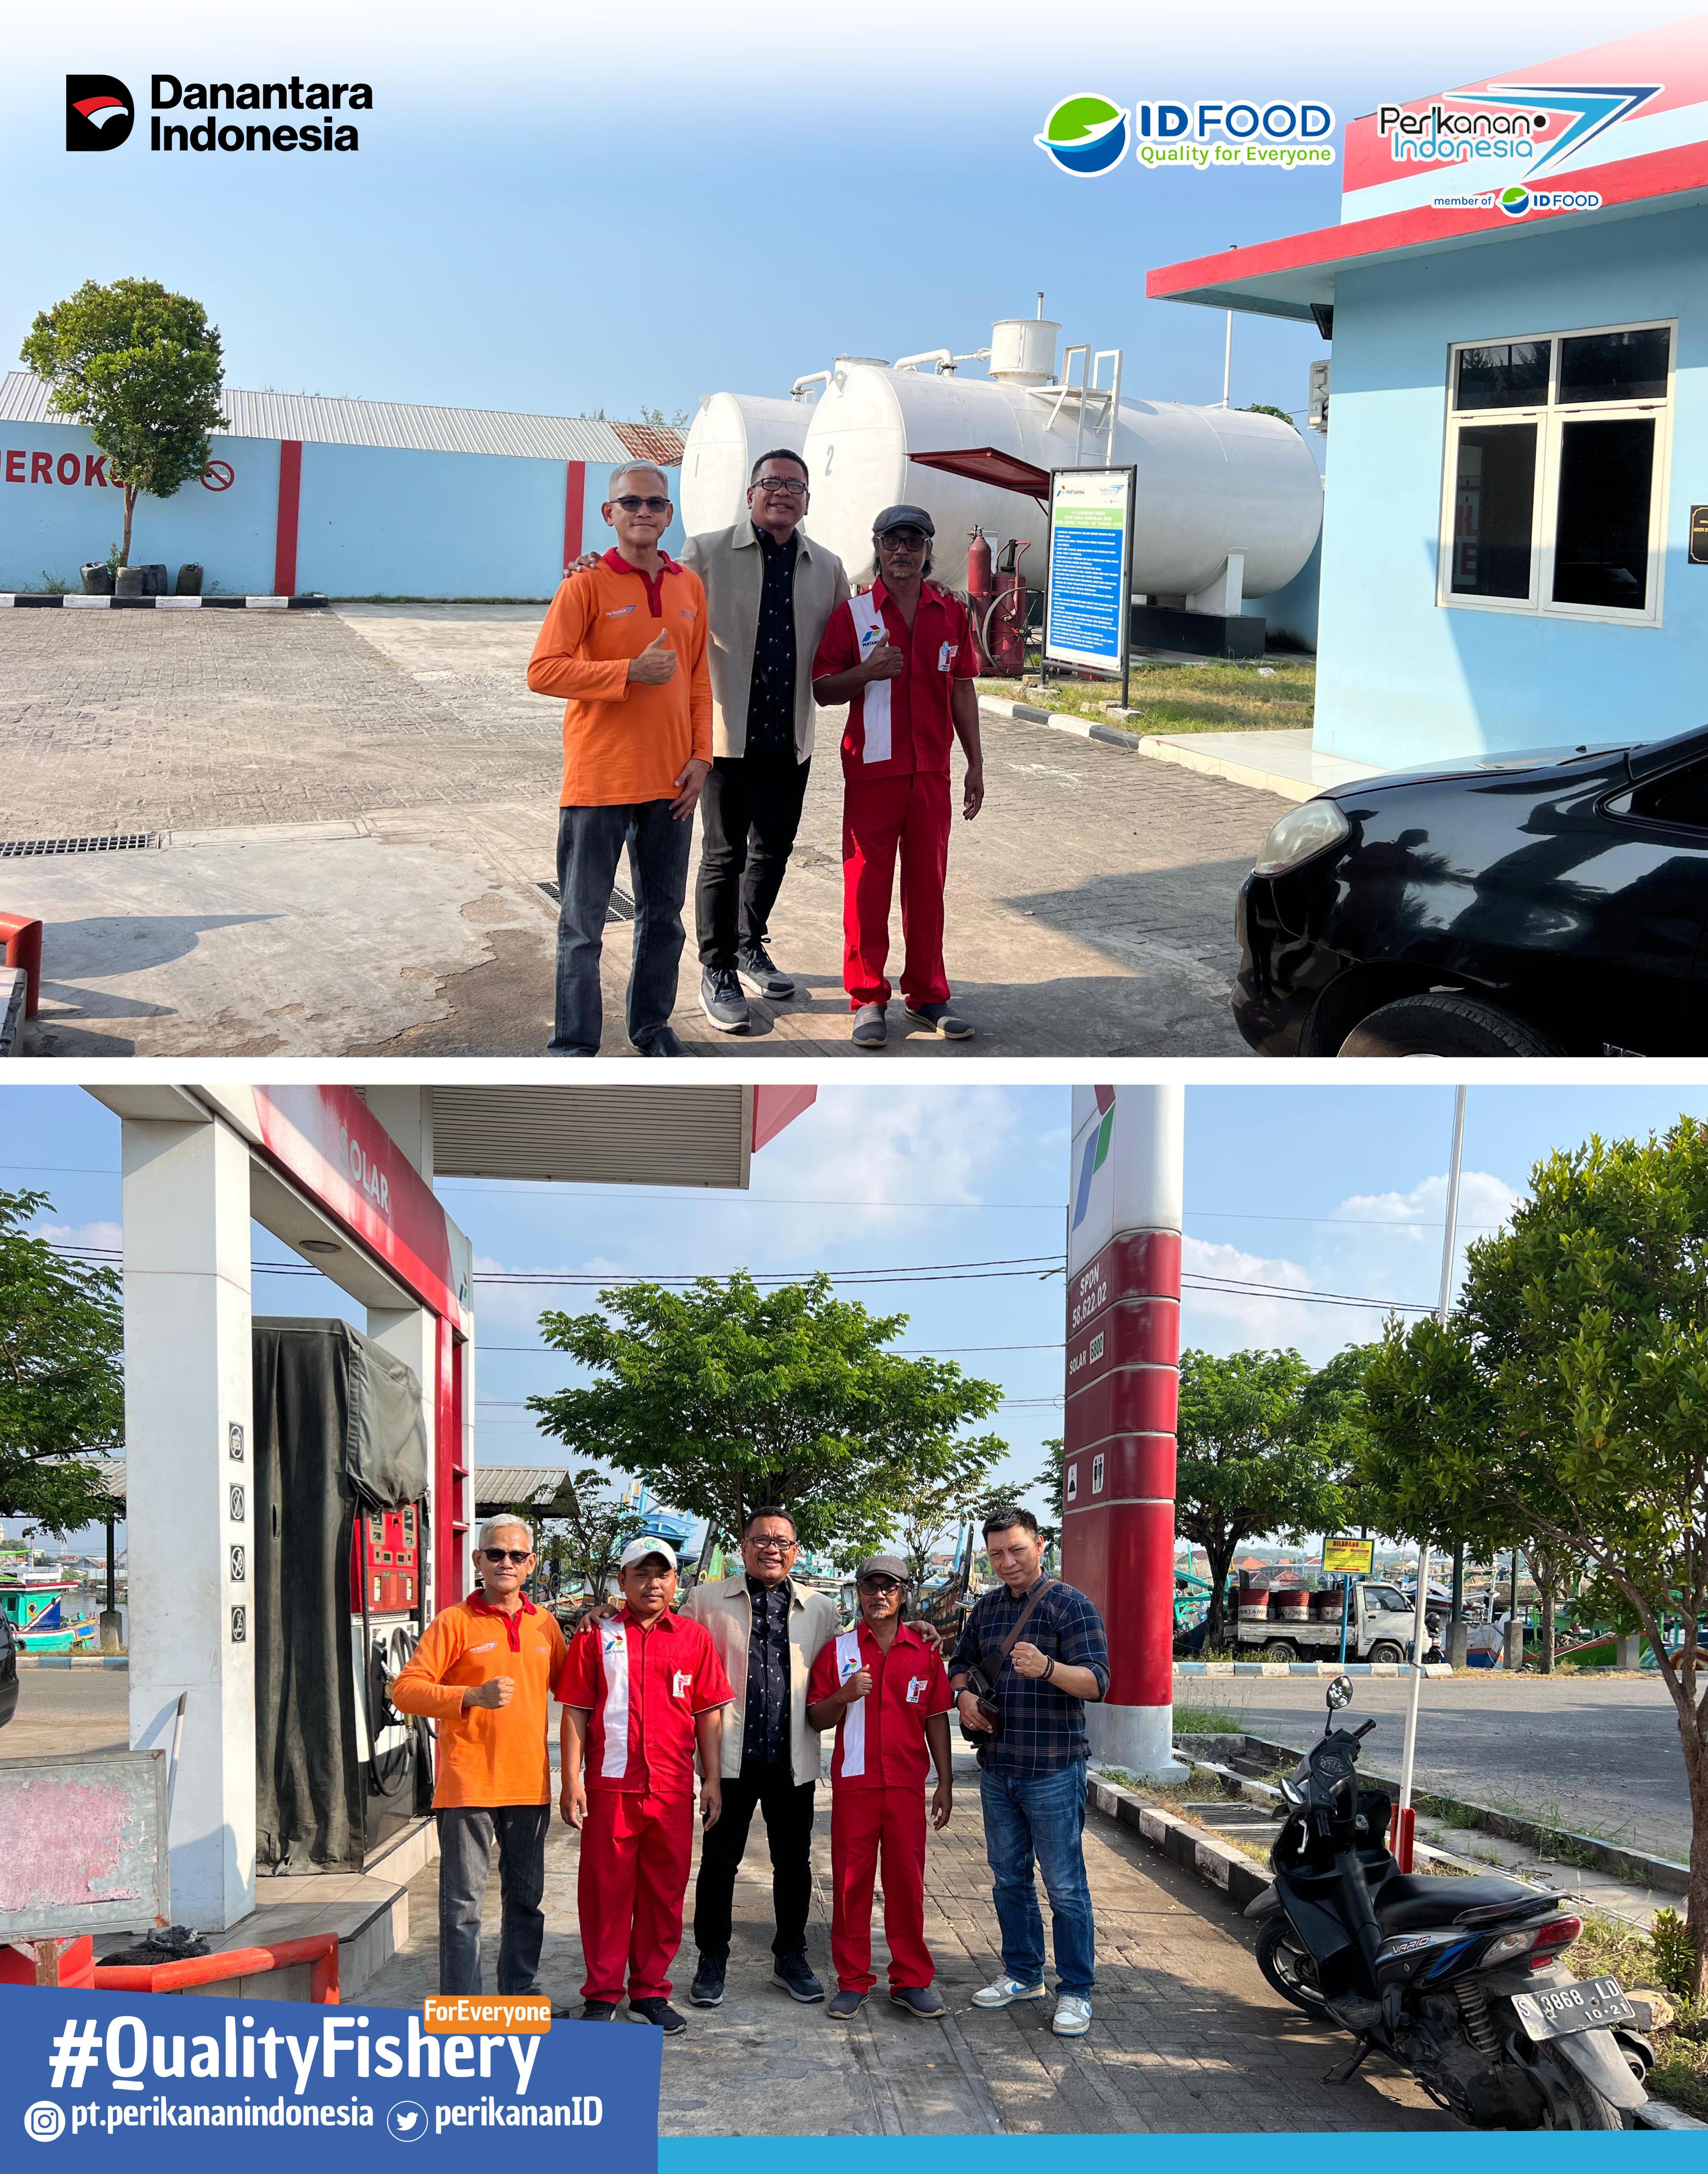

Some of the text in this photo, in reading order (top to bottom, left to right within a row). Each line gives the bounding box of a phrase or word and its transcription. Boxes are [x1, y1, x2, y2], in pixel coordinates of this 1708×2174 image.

[0, 449, 124, 488] EROK
[694, 453, 700, 478] 1
[824, 444, 835, 477] 2
[340, 1126, 389, 1215] SOLAR
[1080, 1262, 1099, 1297] SPDN
[1072, 1281, 1107, 1329] 58.622.02
[1069, 1335, 1103, 1375] SOLAR 6800
[1391, 1936, 1432, 1955] VARIO
[1533, 1966, 1557, 1976] HONDA
[1517, 1980, 1620, 2018] S 3868 LD
